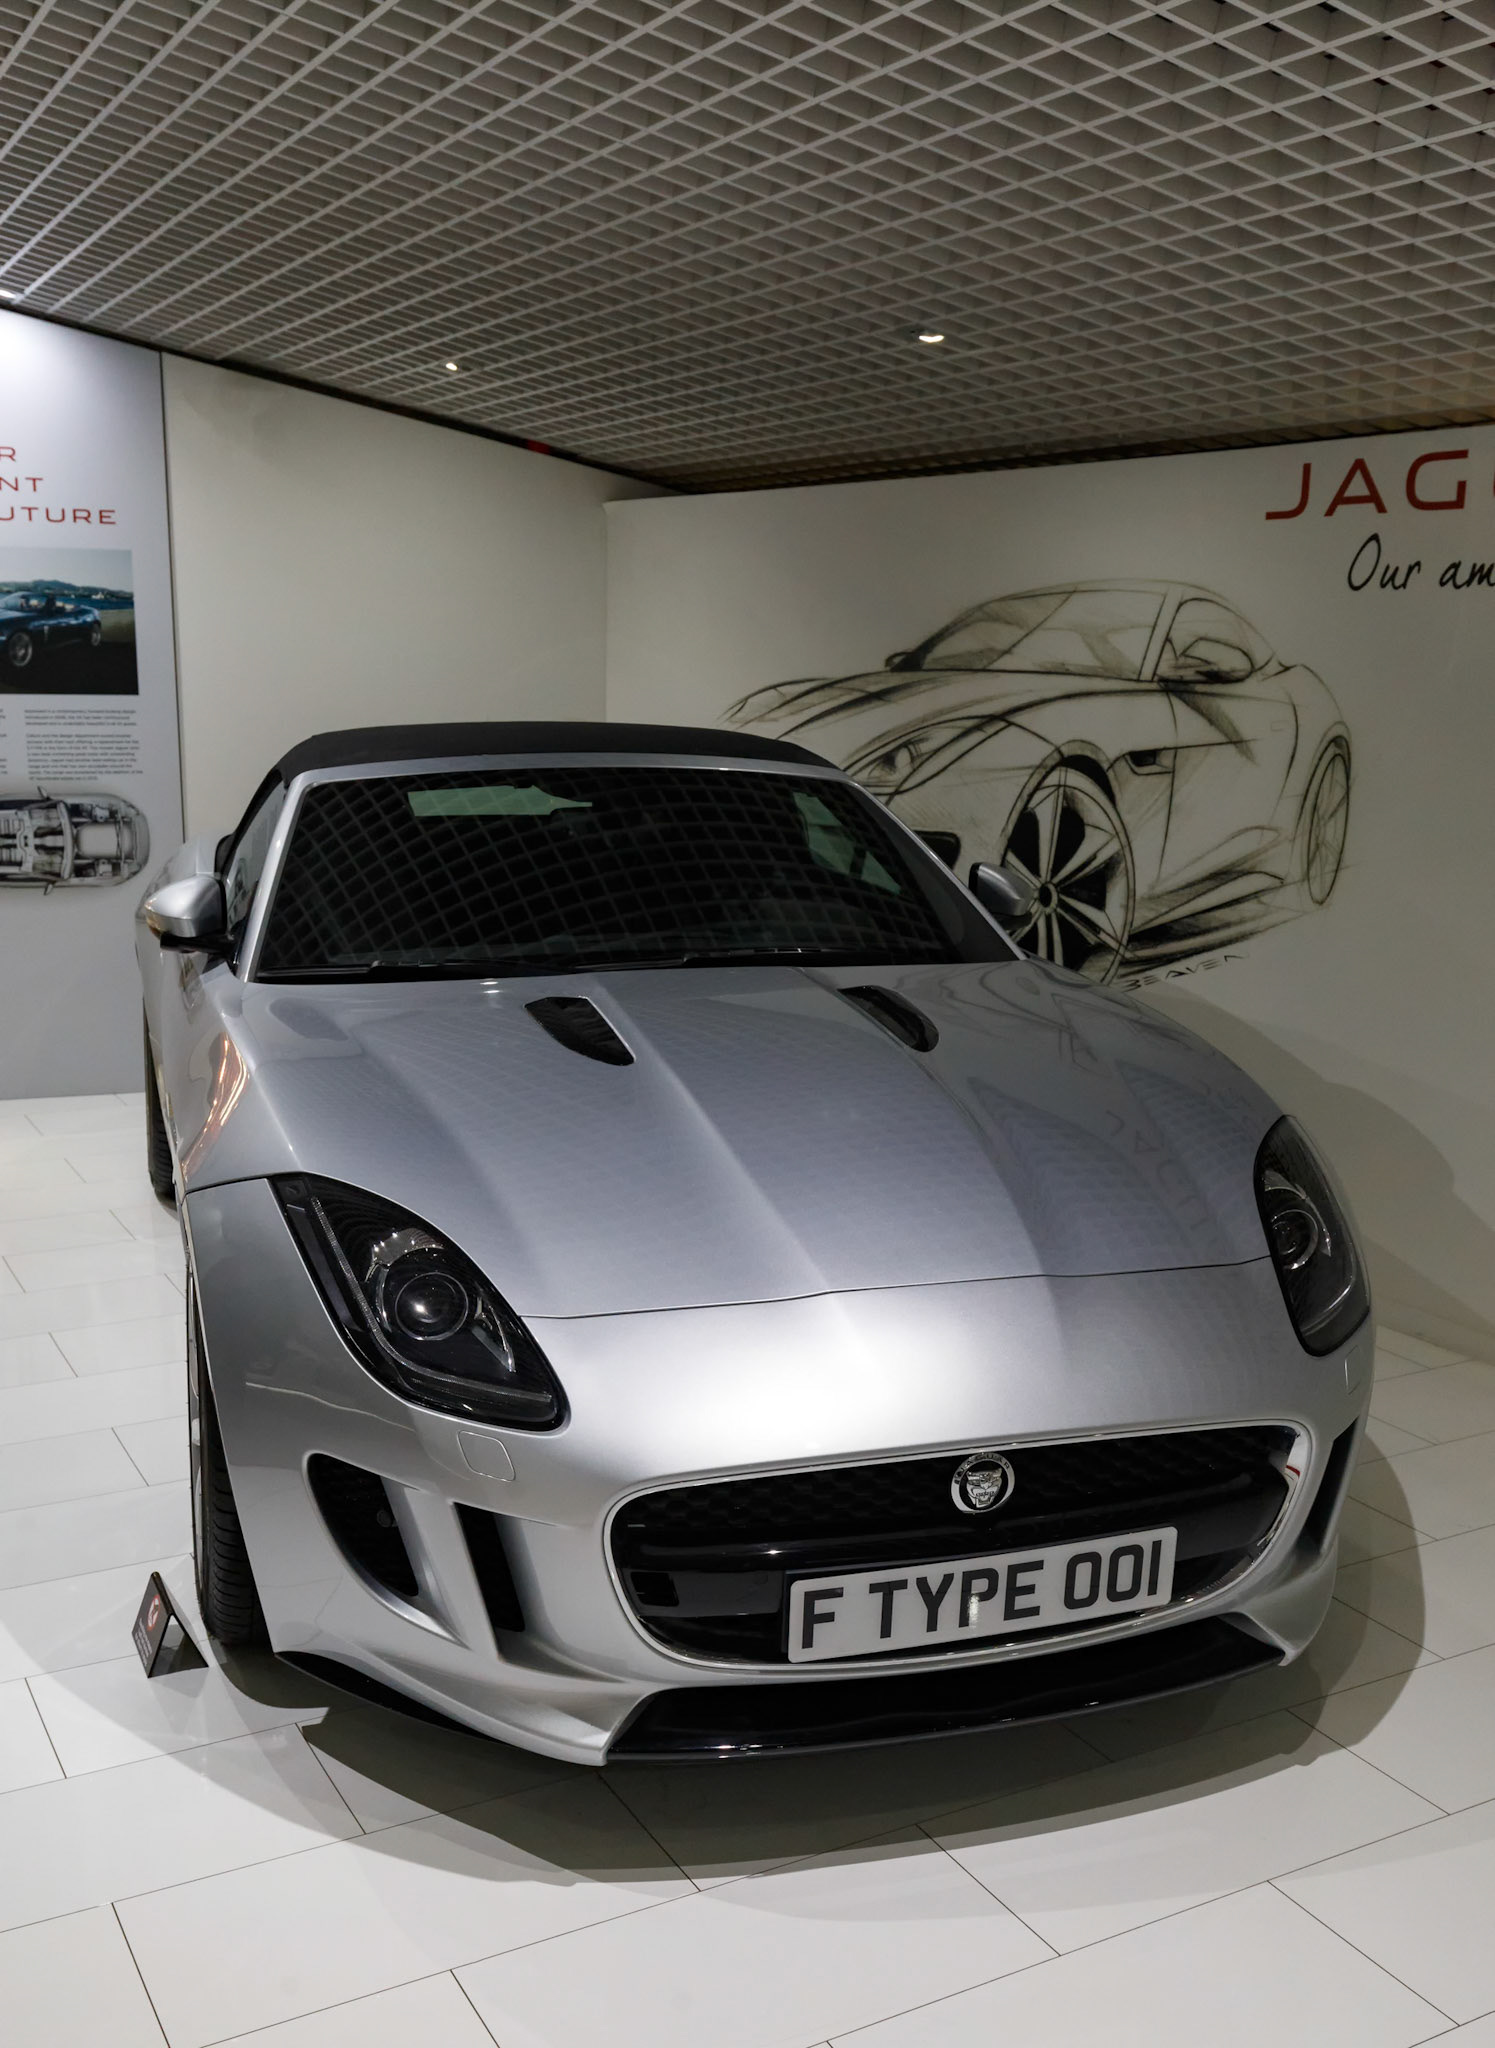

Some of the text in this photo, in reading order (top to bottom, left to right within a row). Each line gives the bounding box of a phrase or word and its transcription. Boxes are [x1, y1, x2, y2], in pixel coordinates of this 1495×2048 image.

[1265, 448, 1495, 520] JAG
[1347, 532, 1421, 591] Our
[801, 1586, 844, 1649] F
[868, 1559, 1045, 1639] TYPE
